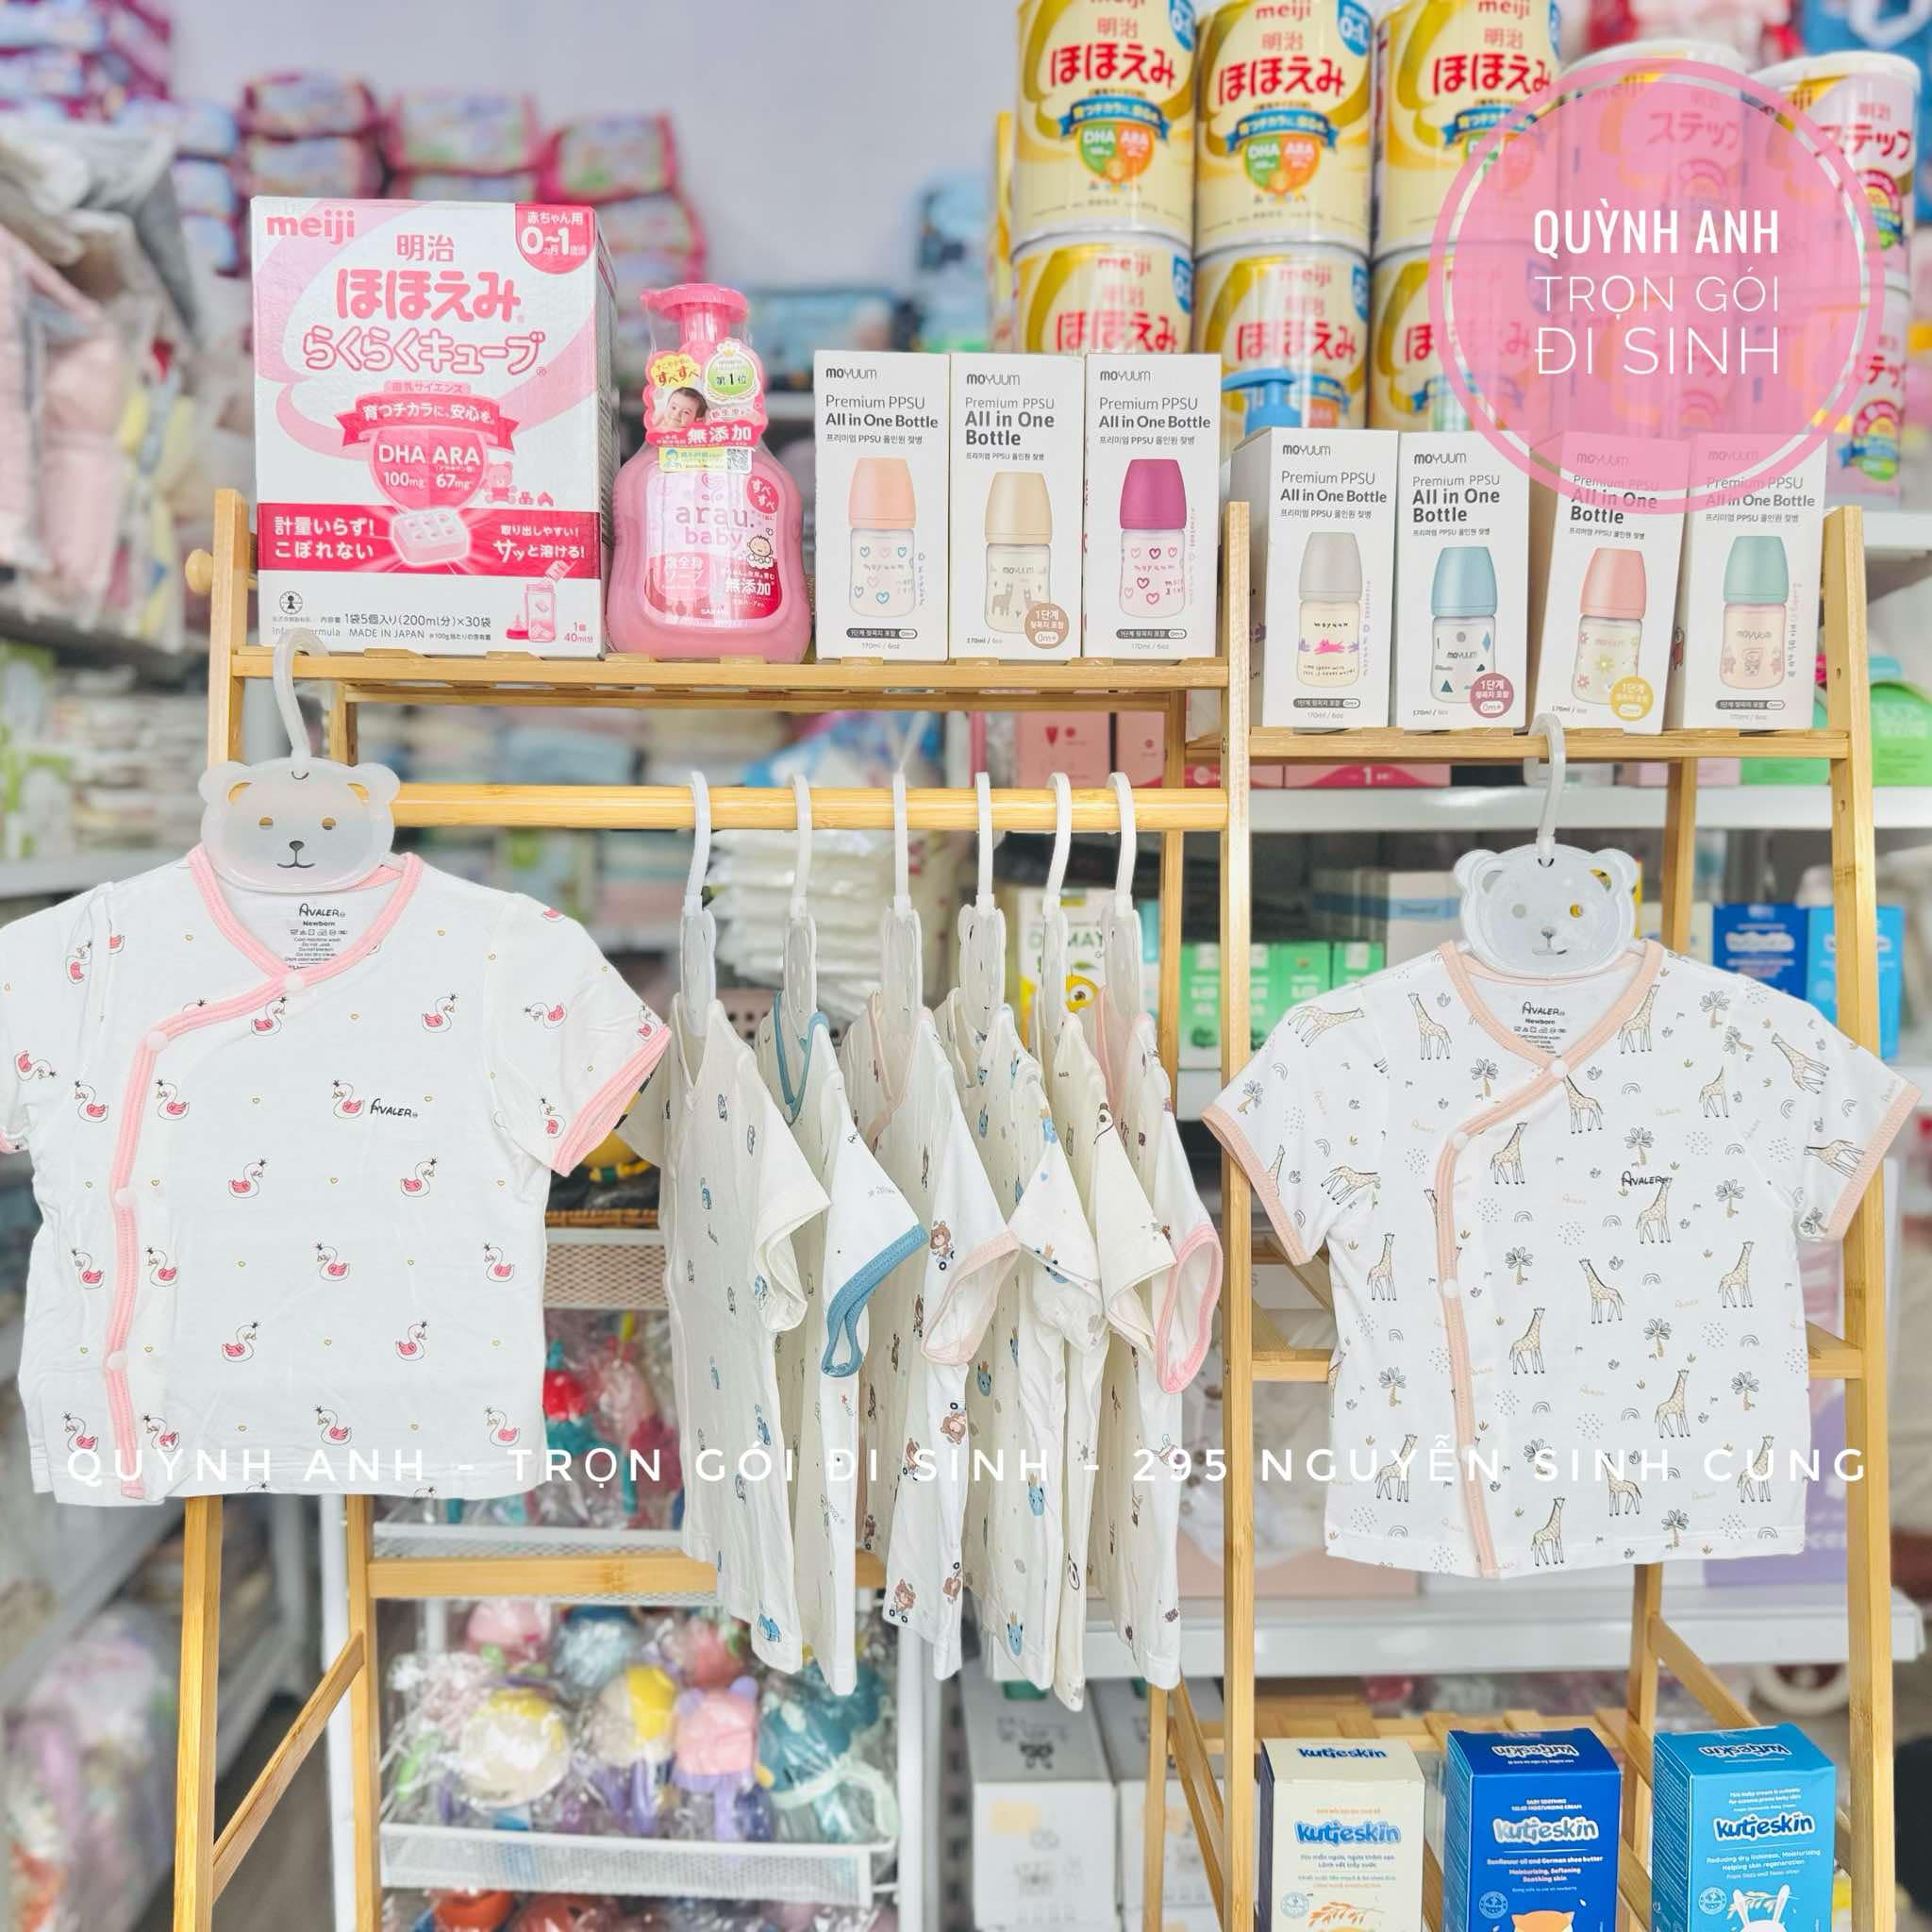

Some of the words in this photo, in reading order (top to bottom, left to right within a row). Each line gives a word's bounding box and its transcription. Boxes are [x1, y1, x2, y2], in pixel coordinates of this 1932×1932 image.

[1256, 3, 1311, 21] meiji
[1097, 18, 1138, 38] 明治
[1262, 31, 1303, 50] 明治
[1051, 42, 1175, 88] ほほえみ
[1219, 56, 1344, 106] ほほえみ
[1433, 54, 1551, 95] ほほえみ
[1083, 129, 1115, 144] DHA
[527, 211, 583, 225] 赤ちゃん用
[267, 210, 356, 243] meiji
[397, 234, 454, 262] 明治
[1097, 254, 1151, 275] meiji
[336, 269, 521, 322] ほほえみ
[1056, 311, 1178, 354] ほほえみ
[303, 325, 545, 375] らくらくキューブ
[1236, 322, 1357, 363] ほほえみ
[825, 369, 876, 379] moyuum
[966, 374, 1020, 385] moyuum
[1100, 371, 1151, 382] moyuum
[825, 394, 886, 408] Premium
[889, 396, 925, 409] PPSU
[965, 397, 1018, 408] Premium
[1023, 397, 1055, 409] PPSU
[1099, 397, 1158, 410] Premium
[1162, 397, 1198, 410] PPSU
[825, 413, 846, 426] All
[848, 413, 861, 426] in
[864, 414, 892, 427] One
[895, 414, 939, 428] Bottle
[965, 411, 990, 426] All
[996, 410, 1012, 426] in
[1018, 411, 1055, 427] One
[1099, 415, 1119, 427] All
[1122, 415, 1134, 427] in
[1136, 415, 1166, 428] One
[1168, 415, 1211, 428] Bottle
[687, 425, 752, 443] 無添加
[858, 434, 881, 443] PPSU
[965, 429, 1021, 445] Bottle
[378, 445, 425, 464] DHA
[432, 445, 481, 465] ARA
[1282, 444, 1331, 456] moyuum
[1414, 453, 1467, 464] moyuum
[384, 472, 425, 489] 100mg
[436, 474, 471, 491] 67mg
[1281, 470, 1338, 484] Premium
[1341, 473, 1375, 485] PPSU
[1413, 476, 1464, 487] Premium
[1469, 475, 1500, 486] PPSU
[1706, 476, 1766, 490] Premium
[1768, 476, 1804, 490] PPSU
[1280, 489, 1301, 502] All
[1302, 490, 1315, 502] in
[1317, 490, 1344, 503] One
[1346, 491, 1387, 504] Bottle
[1412, 489, 1438, 505] All
[1442, 489, 1459, 505] in
[1463, 489, 1500, 504] One
[1706, 494, 1726, 507] All
[1727, 494, 1740, 507] in
[1742, 494, 1771, 507] One
[1773, 494, 1815, 507] Bottle
[1310, 509, 1333, 519] PPSU
[1413, 507, 1468, 523] Bottle
[1570, 506, 1624, 525] Bottle
[1736, 514, 1758, 523] PPSU
[685, 526, 743, 551] baby
[1594, 529, 1612, 538] PPSU
[275, 541, 374, 560] こぼれない
[724, 577, 771, 596] 無添加
[349, 627, 377, 638] MADE
[380, 628, 391, 638] IN
[394, 628, 425, 639] JAPAN
[1480, 679, 1505, 691] 1단계
